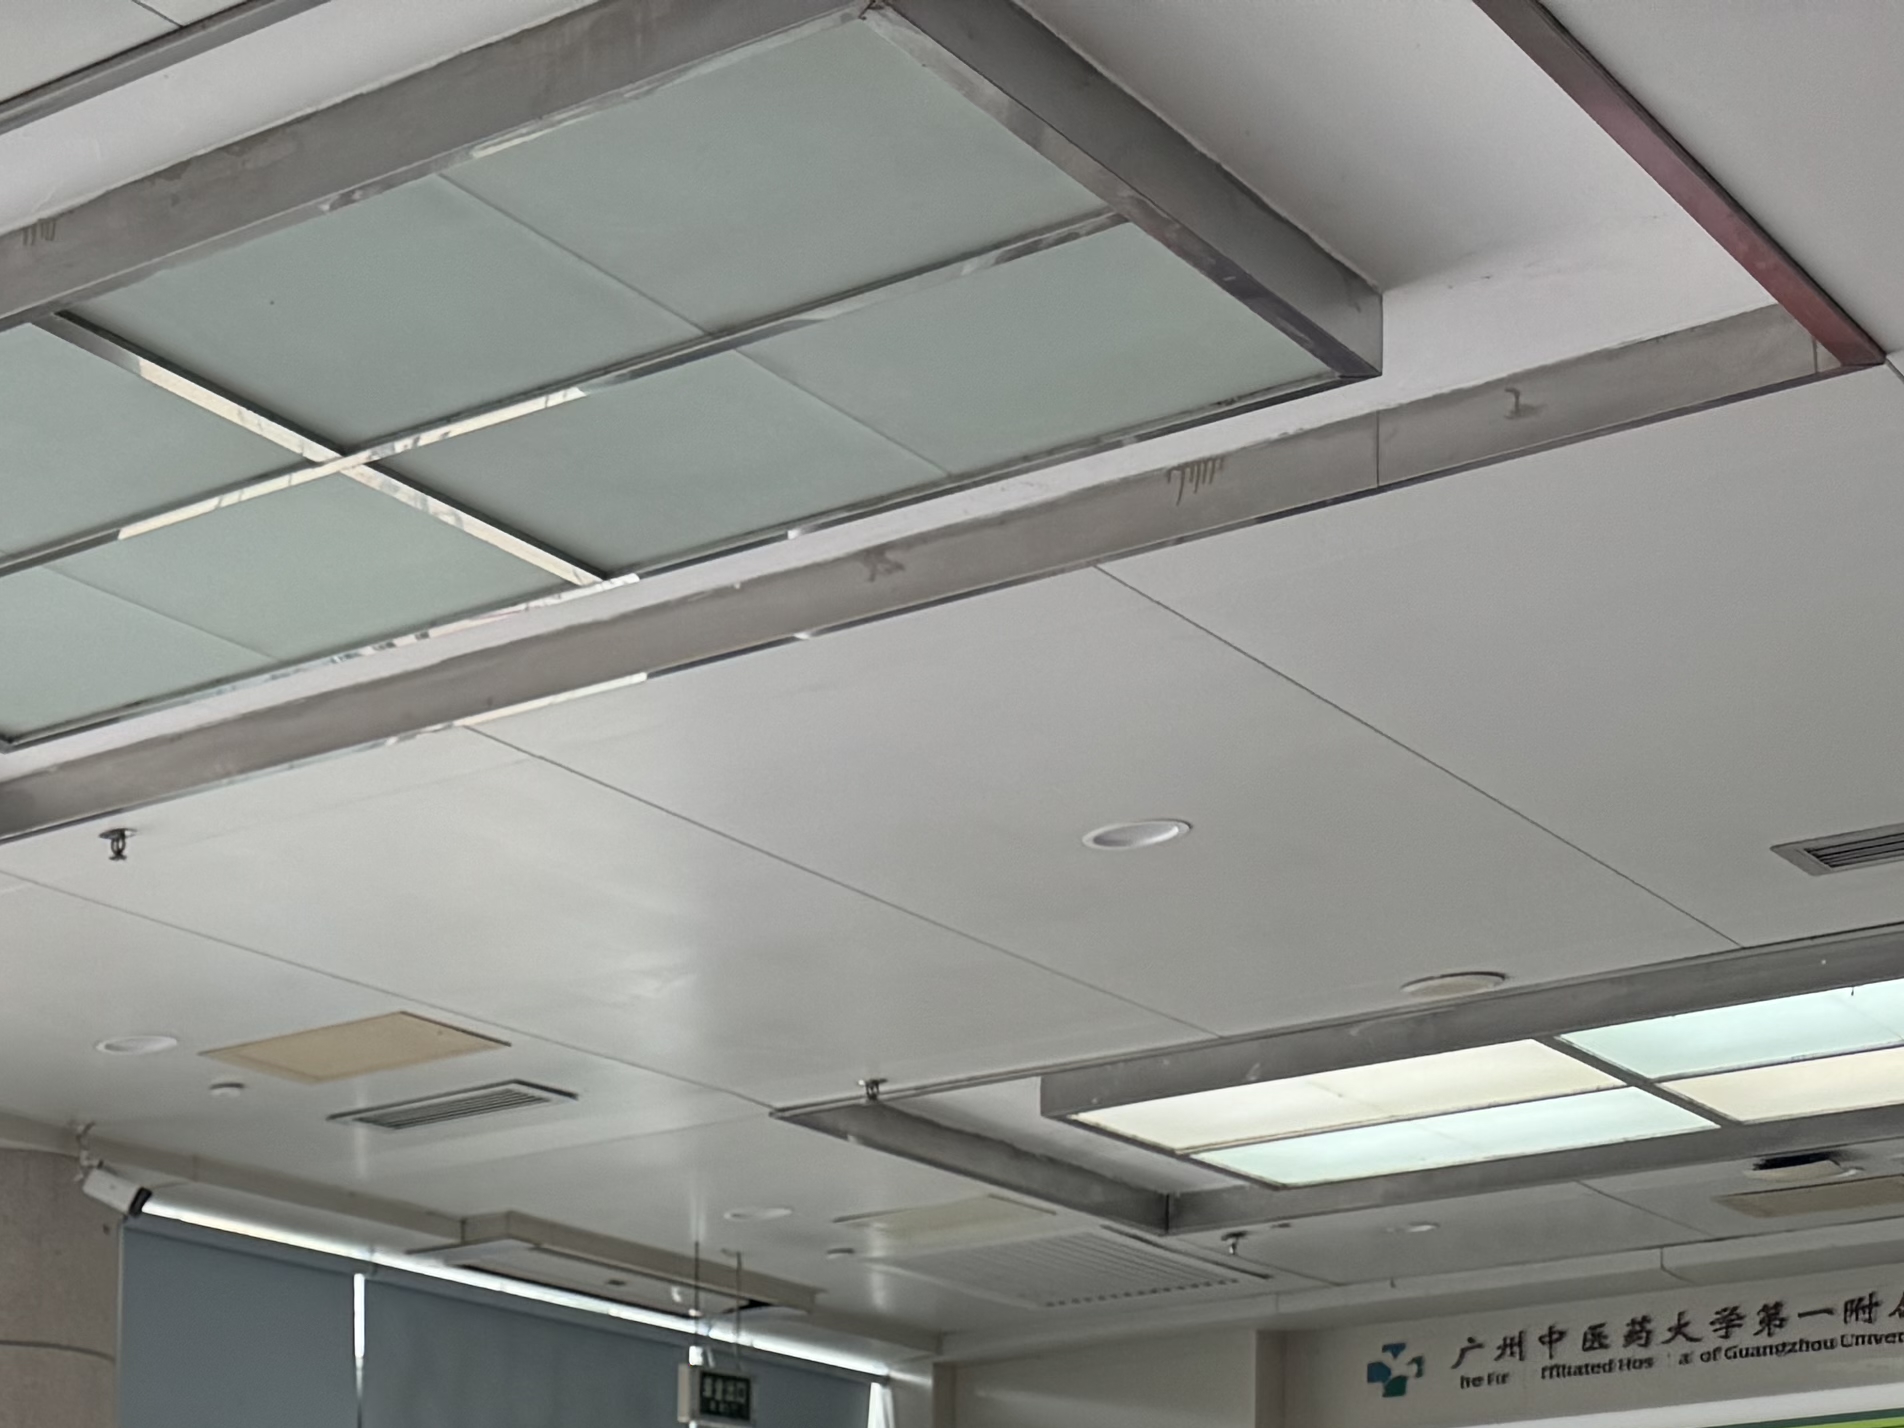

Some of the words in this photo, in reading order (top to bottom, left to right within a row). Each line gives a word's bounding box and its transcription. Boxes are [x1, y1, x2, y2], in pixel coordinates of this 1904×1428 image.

[1460, 1375, 1485, 1390] he
[1541, 1357, 1613, 1380] ffiliated
[1700, 1346, 1719, 1363] of
[1724, 1337, 1837, 1361] Guangzhou
[1840, 1331, 1904, 1348] Univer
